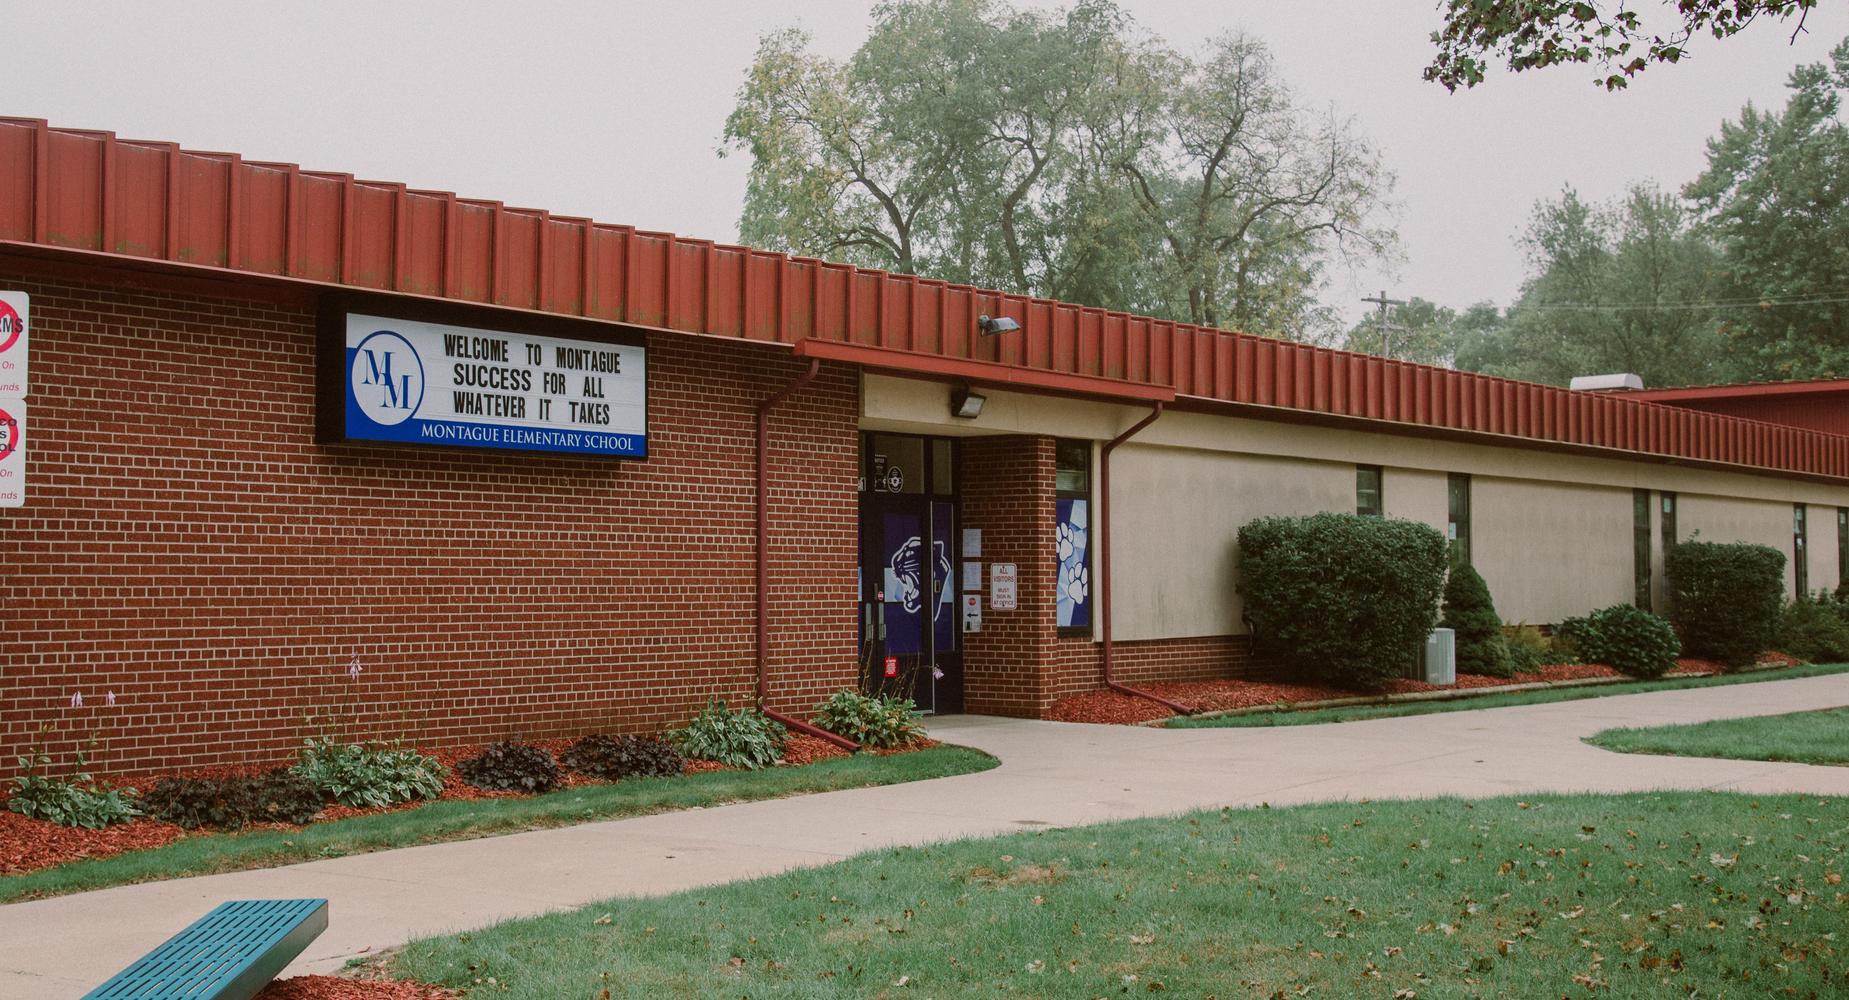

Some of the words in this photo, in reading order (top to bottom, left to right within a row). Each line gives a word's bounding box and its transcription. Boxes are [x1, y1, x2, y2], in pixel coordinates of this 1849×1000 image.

[0, 317, 23, 333] MS
[2, 360, 15, 369] On
[444, 333, 509, 363] WELCOME
[525, 343, 542, 366] TO
[556, 346, 621, 374] MONTAGUE
[453, 363, 532, 391] SUCCESS
[543, 372, 566, 395] FOR
[583, 376, 605, 398] ALL
[453, 391, 526, 418] WHATEVER
[539, 398, 552, 421] IT
[569, 401, 610, 425] TAKES
[421, 423, 500, 442] MONTAGUE
[502, 429, 582, 447] ELEMENTARY
[584, 434, 634, 451] SCHOOL
[0, 468, 13, 478] On
